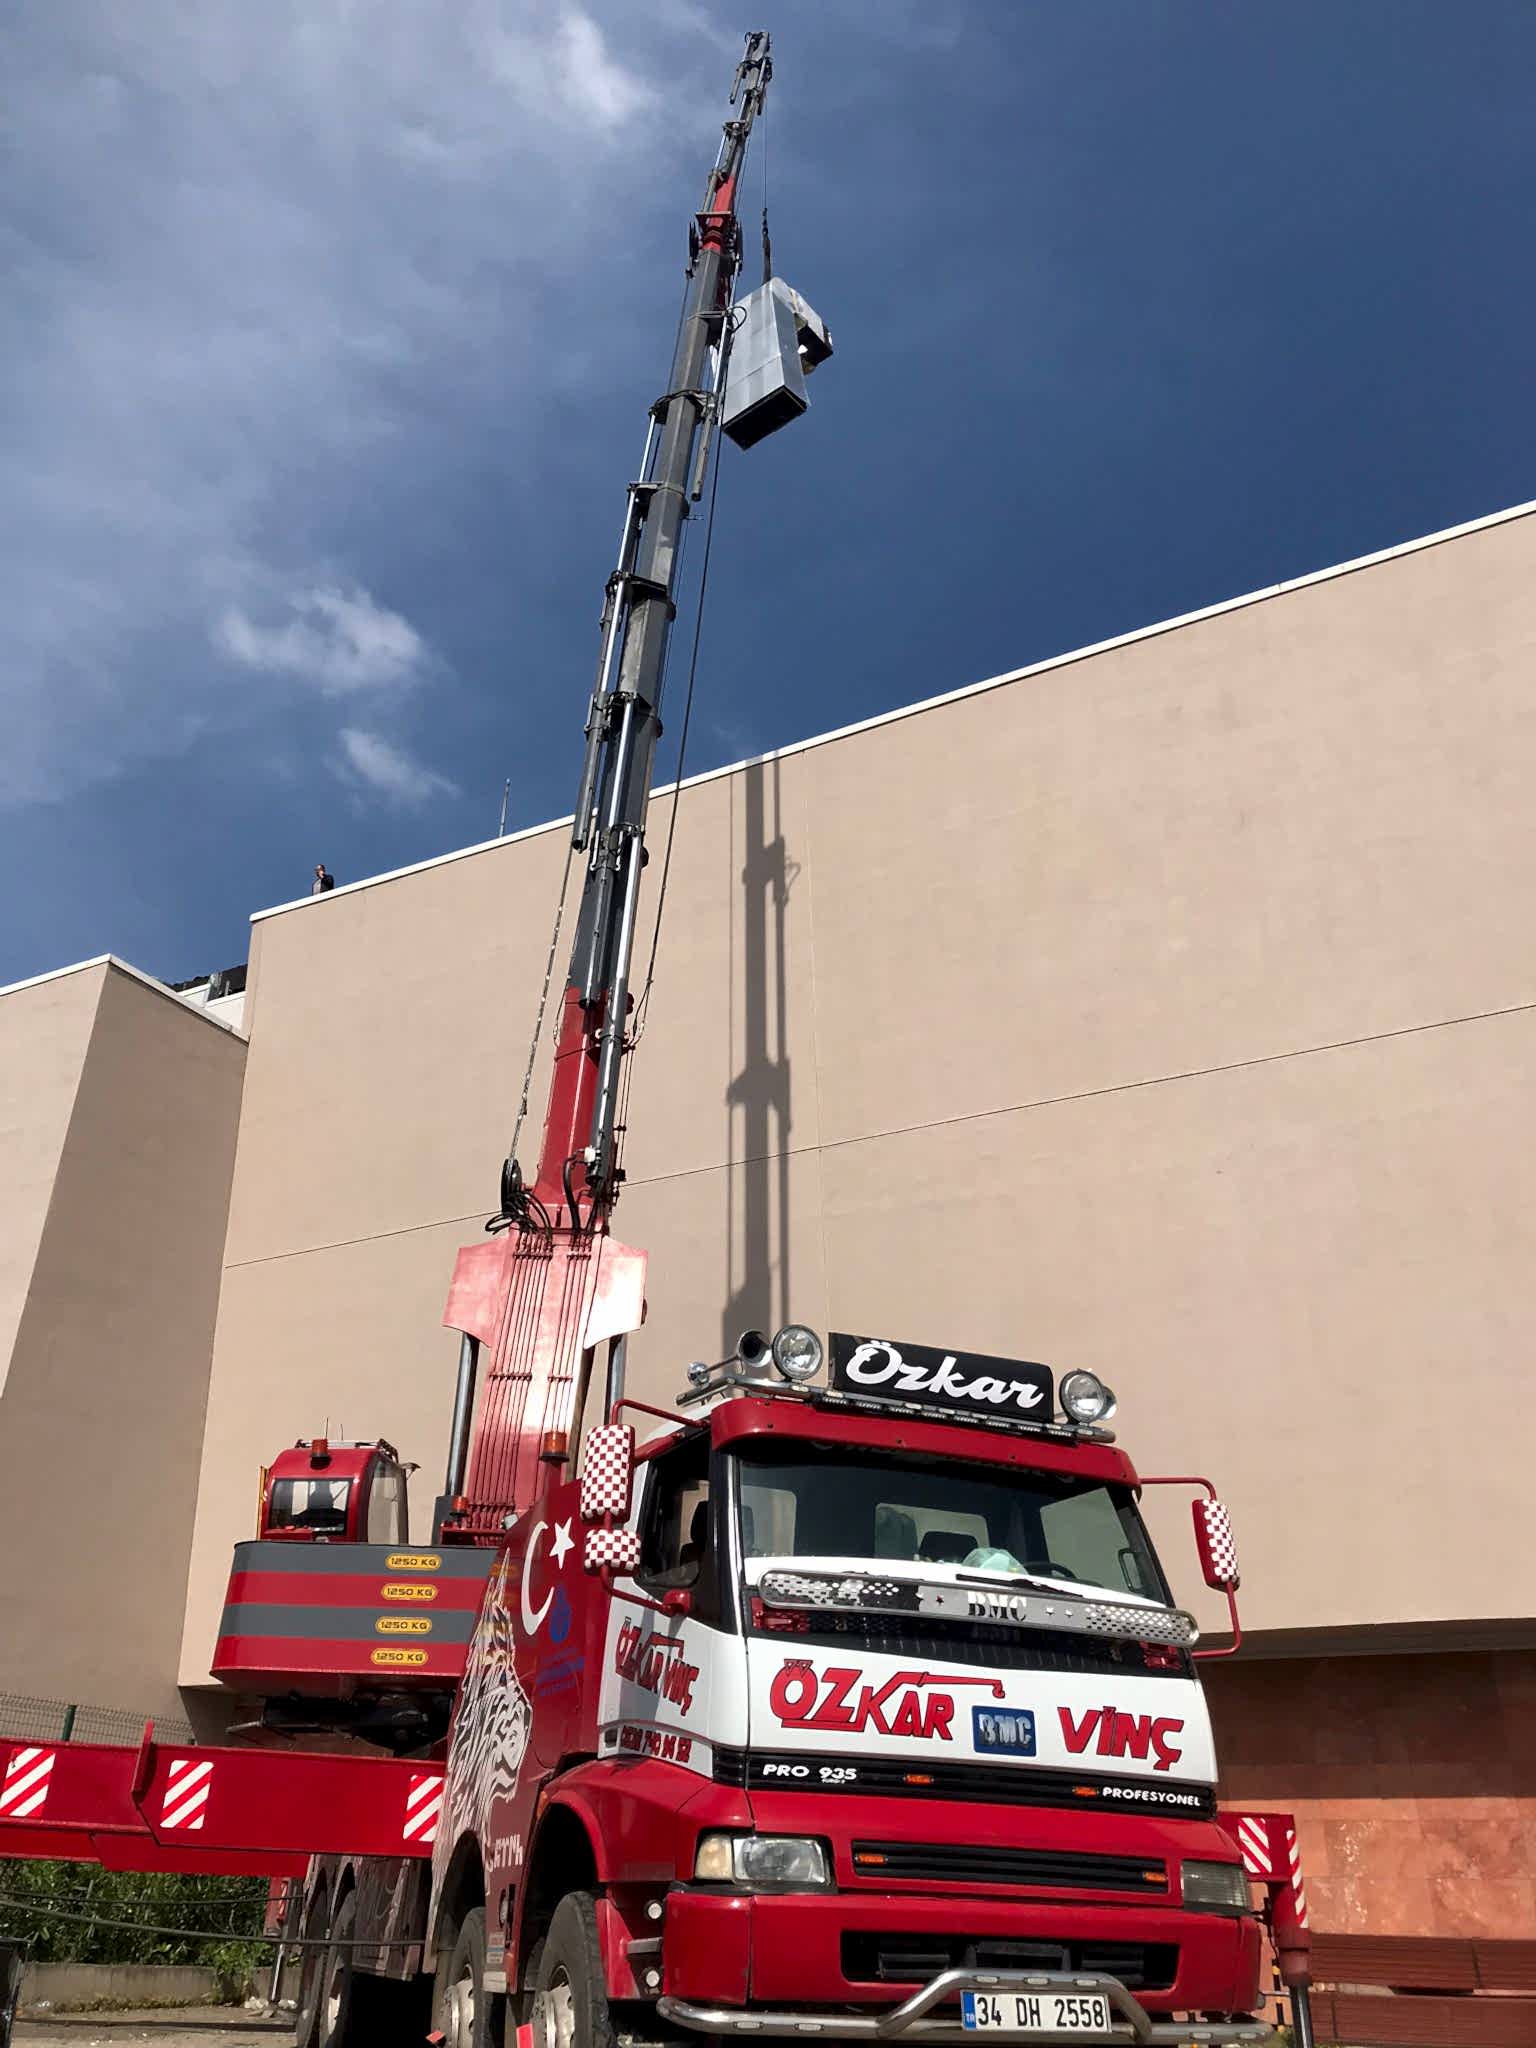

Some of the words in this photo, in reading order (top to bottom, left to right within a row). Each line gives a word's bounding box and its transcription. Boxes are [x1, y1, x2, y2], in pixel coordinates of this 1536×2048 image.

[846, 1340, 1044, 1408] Özkar
[391, 1557, 418, 1566] 1250
[421, 1559, 437, 1567] KG
[387, 1587, 414, 1596] 1250
[417, 1588, 433, 1597] KG
[967, 1590, 1027, 1622] BMC
[381, 1620, 408, 1629] 1250
[411, 1621, 427, 1630] KG
[376, 1652, 404, 1661] 1250
[407, 1653, 423, 1662] KG
[769, 1658, 956, 1741] ÖZKAR
[979, 1713, 1031, 1750] BMC
[763, 1763, 810, 1777] PRO
[818, 1766, 857, 1781] 935
[1102, 1786, 1201, 1807] PROFESYONEL
[976, 1997, 1002, 2026] 34
[1015, 1997, 1041, 2027] DH
[1054, 1998, 1105, 2028] 2558
